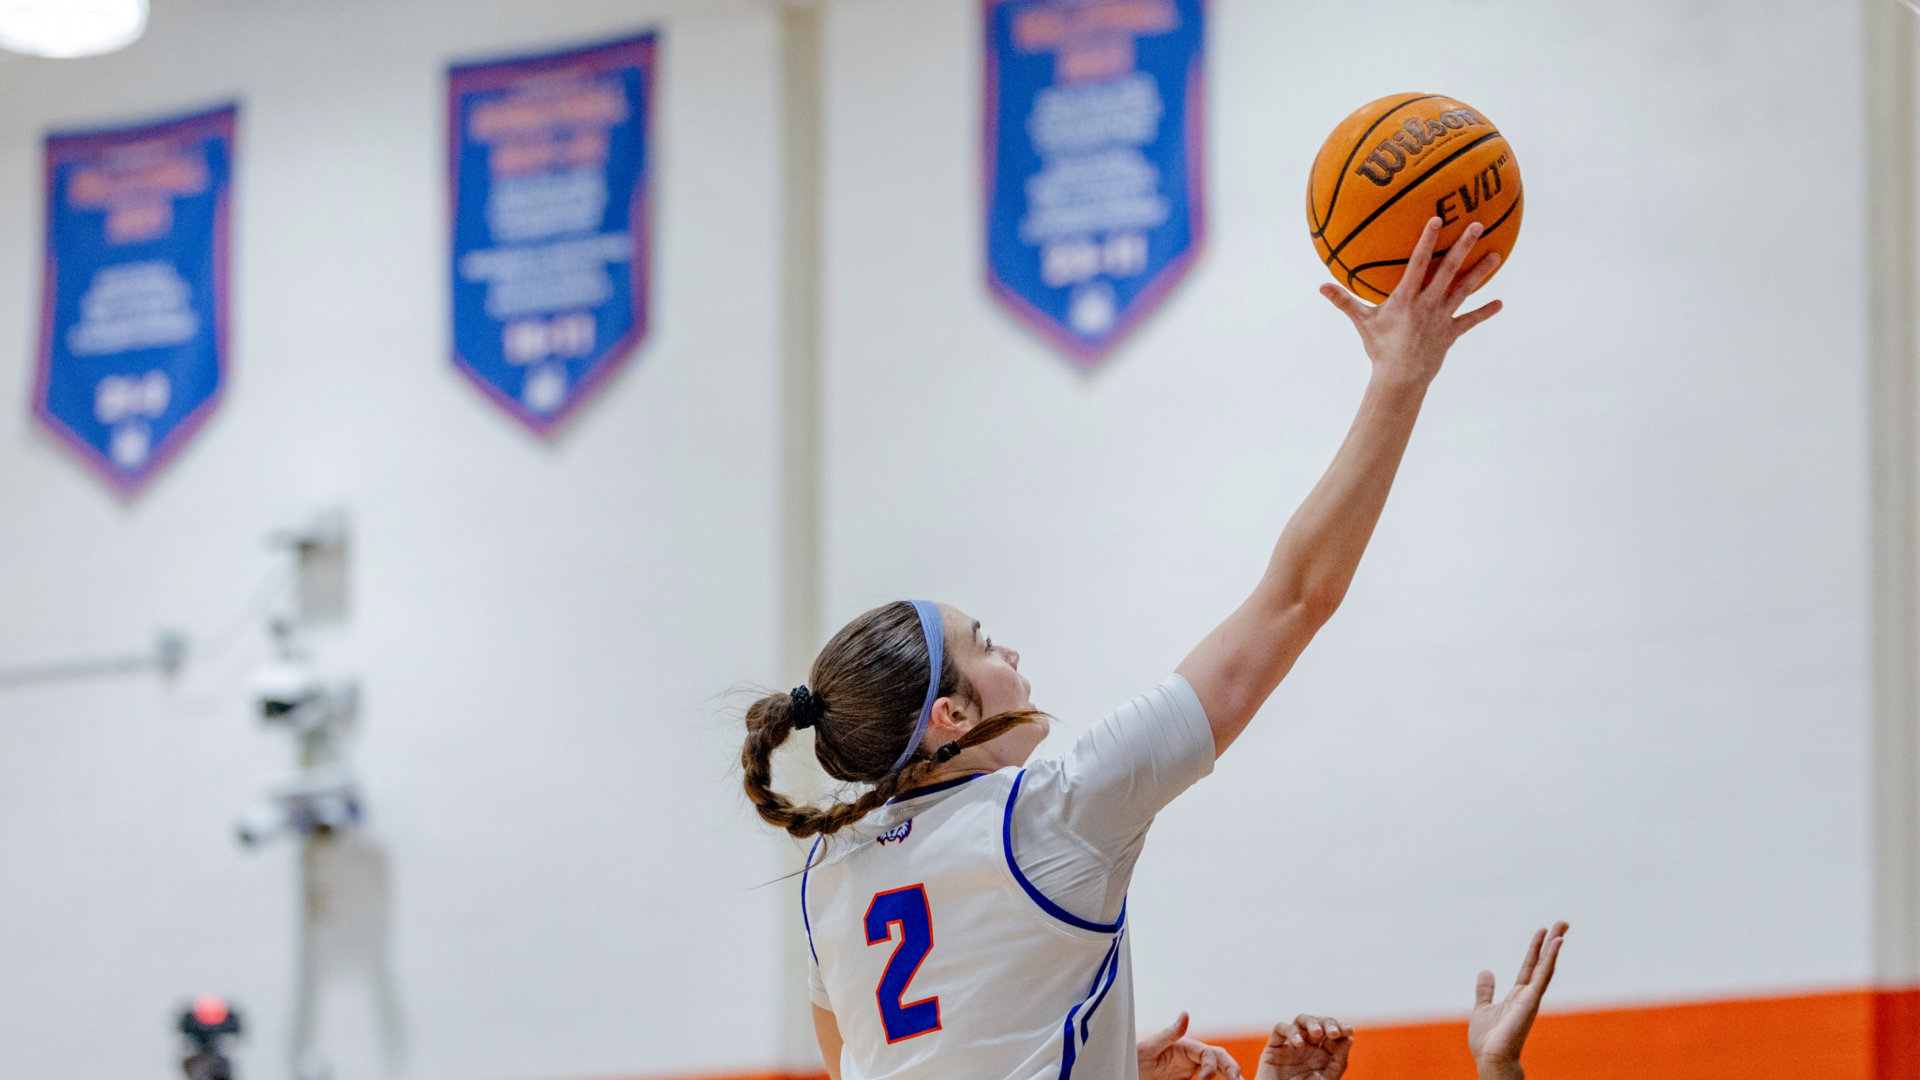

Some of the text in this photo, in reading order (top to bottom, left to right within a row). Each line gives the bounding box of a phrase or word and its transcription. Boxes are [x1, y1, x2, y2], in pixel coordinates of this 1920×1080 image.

[1355, 108, 1485, 187] Wilson
[1435, 160, 1501, 228] EVO
[863, 883, 942, 1044] 2
